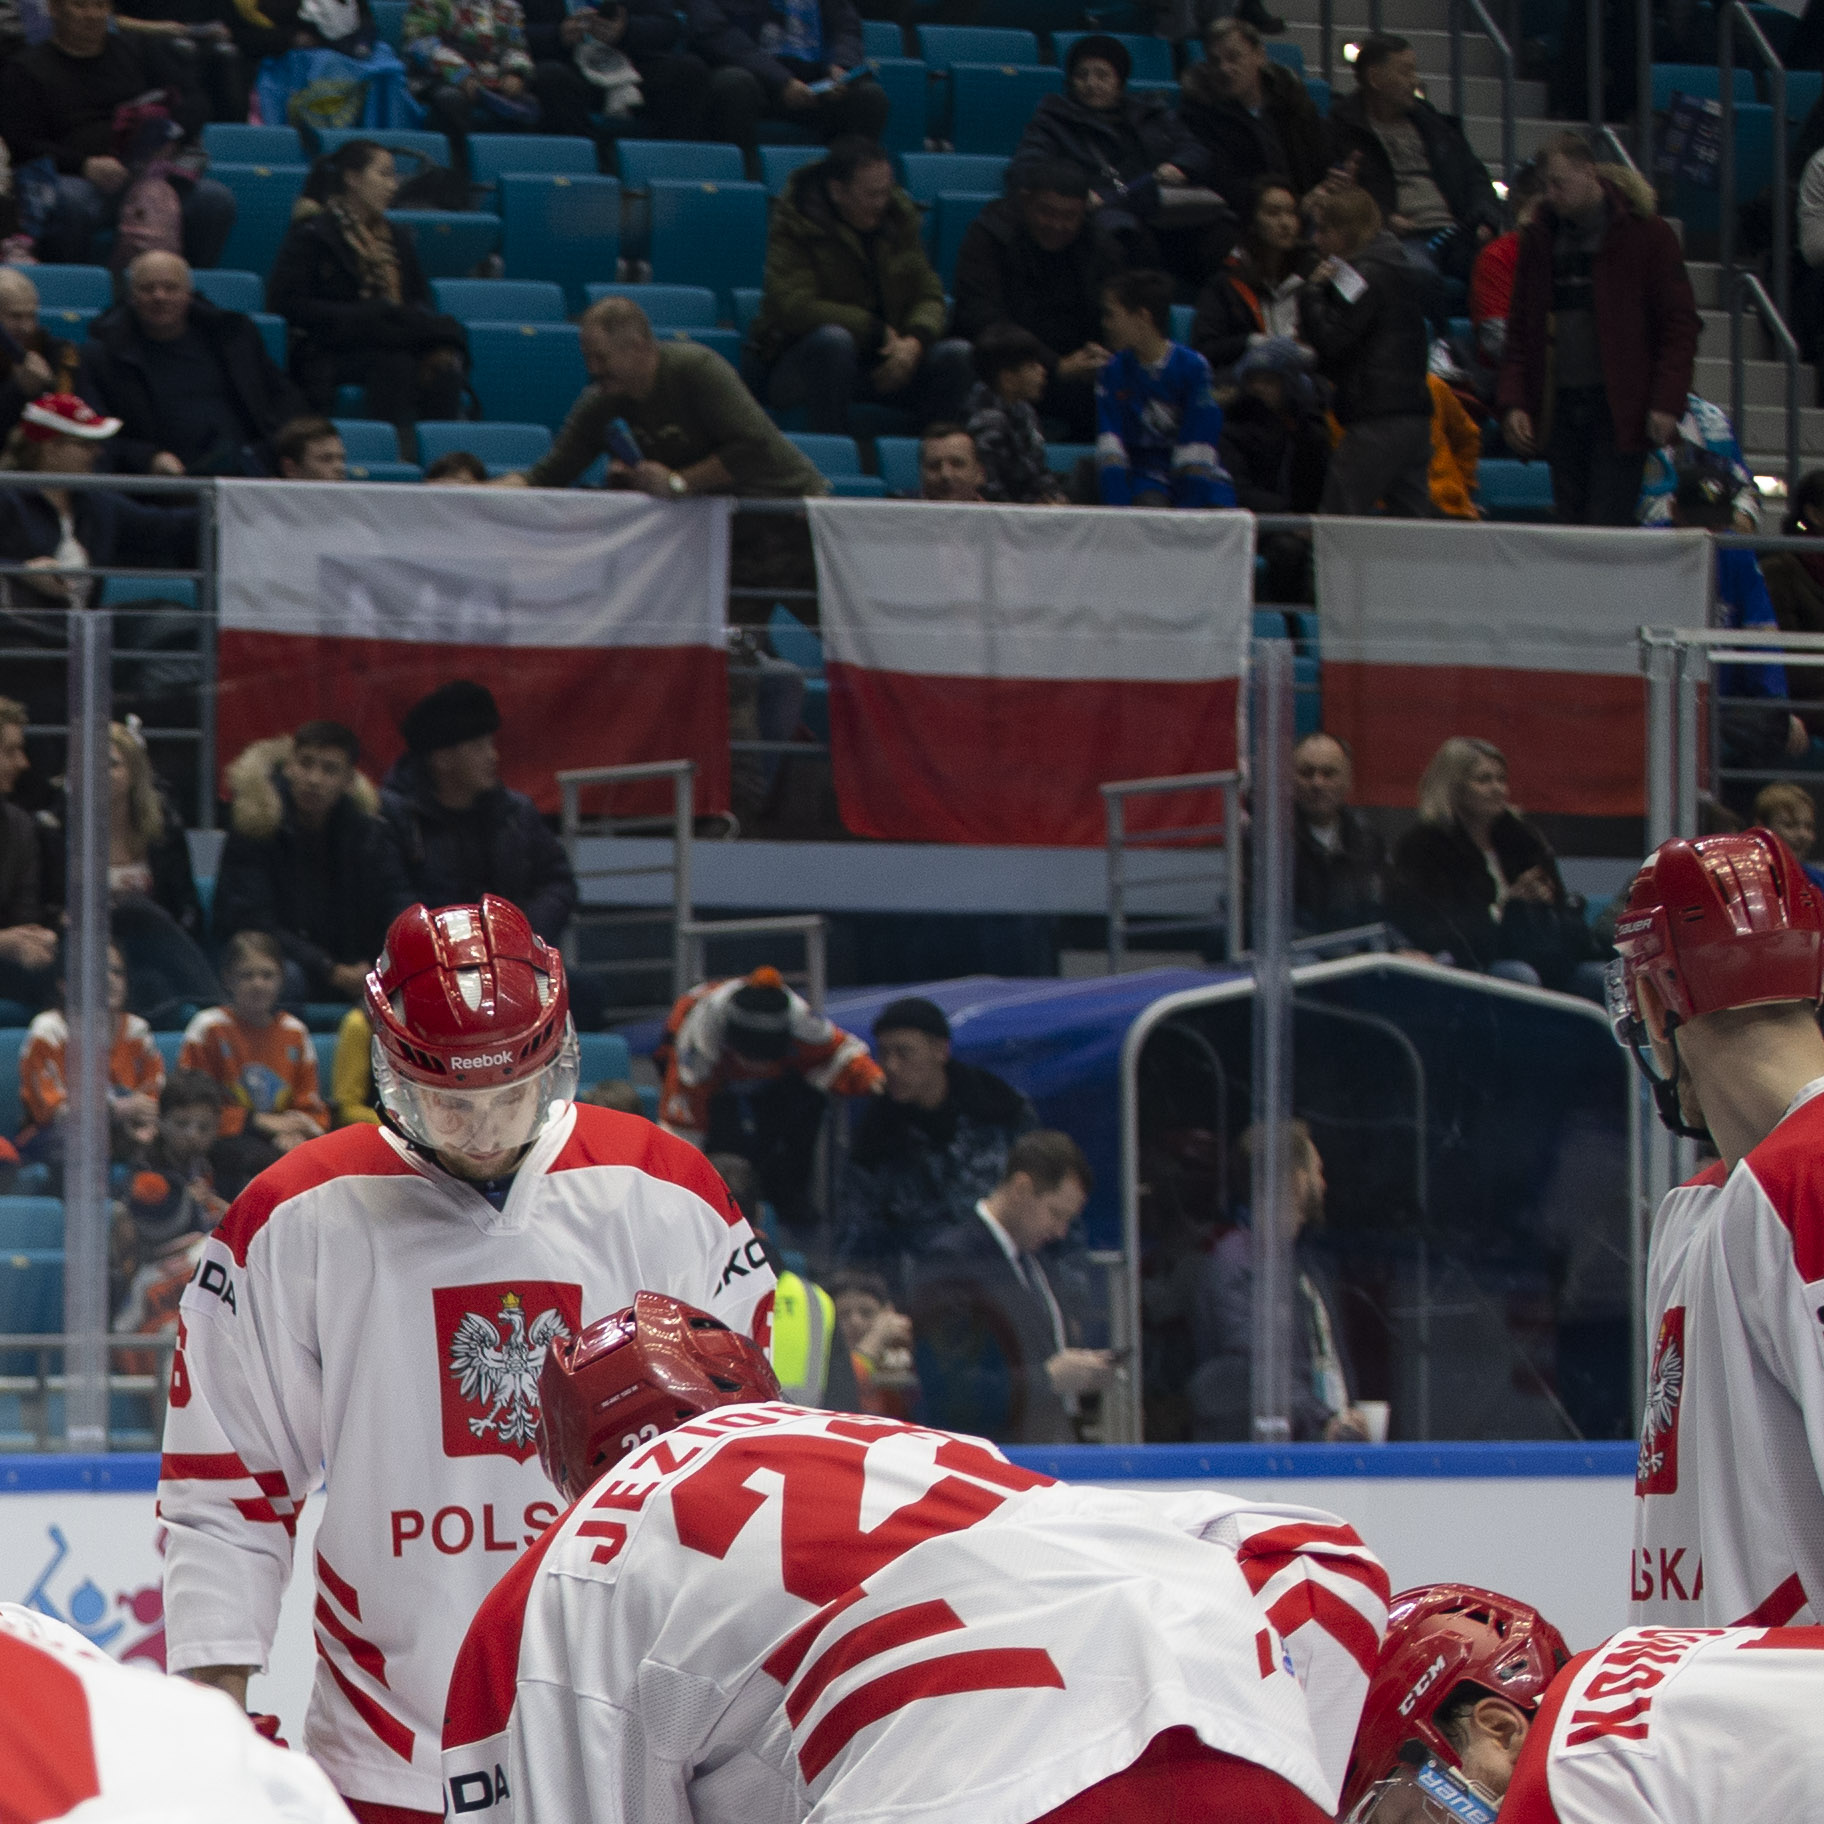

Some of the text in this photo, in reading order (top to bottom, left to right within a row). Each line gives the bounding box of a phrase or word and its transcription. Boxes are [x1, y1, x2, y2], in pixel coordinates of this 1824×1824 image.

[450, 1050, 514, 1072] Reebok
[390, 1505, 558, 1558] POLS
[1398, 1654, 1445, 1716] CCM
